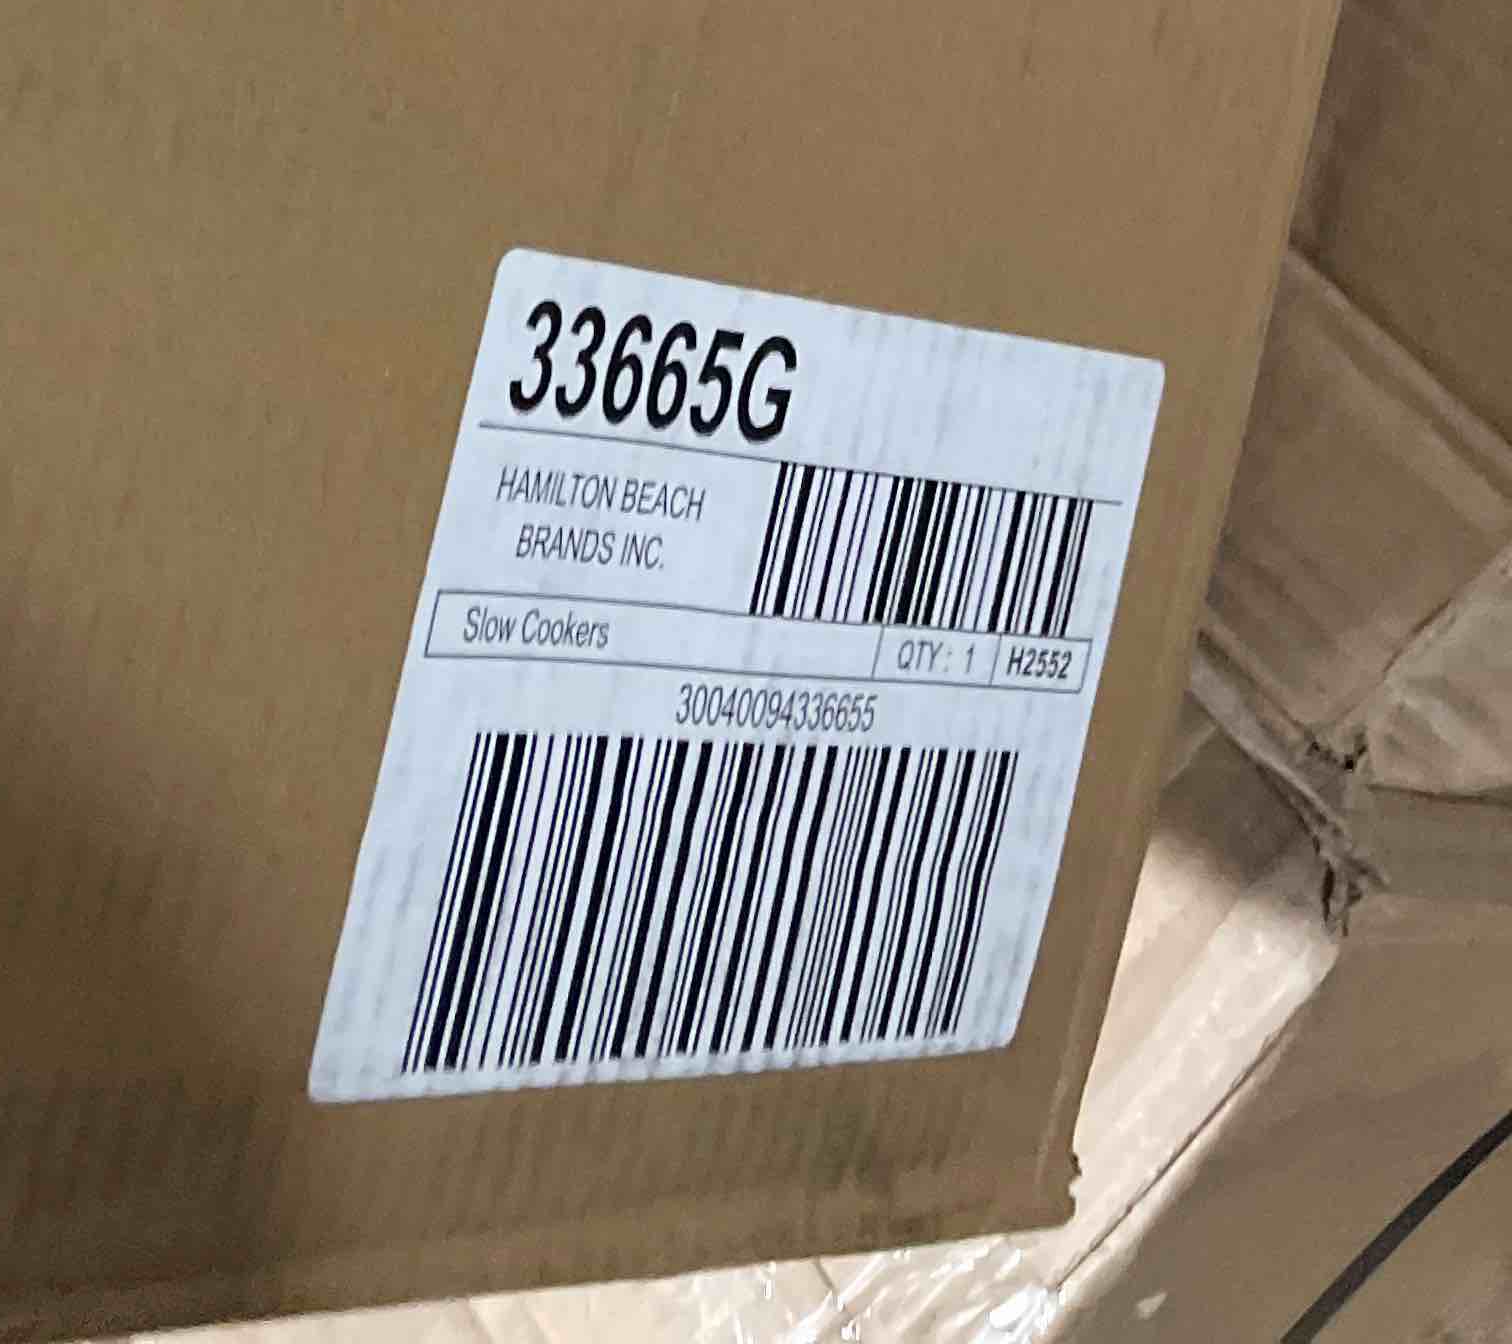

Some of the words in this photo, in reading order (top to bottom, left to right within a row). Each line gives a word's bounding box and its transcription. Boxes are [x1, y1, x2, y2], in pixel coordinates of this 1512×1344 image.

[508, 299, 798, 444] 33665G
[496, 463, 619, 510] HAMILTON
[619, 477, 707, 523] BEACH
[515, 523, 616, 566] BRANDS
[619, 532, 666, 571] INC.
[462, 605, 517, 646] Slow
[520, 606, 610, 650] Cookers
[1007, 646, 1073, 680] H2552
[674, 682, 879, 733] 30040094336655
